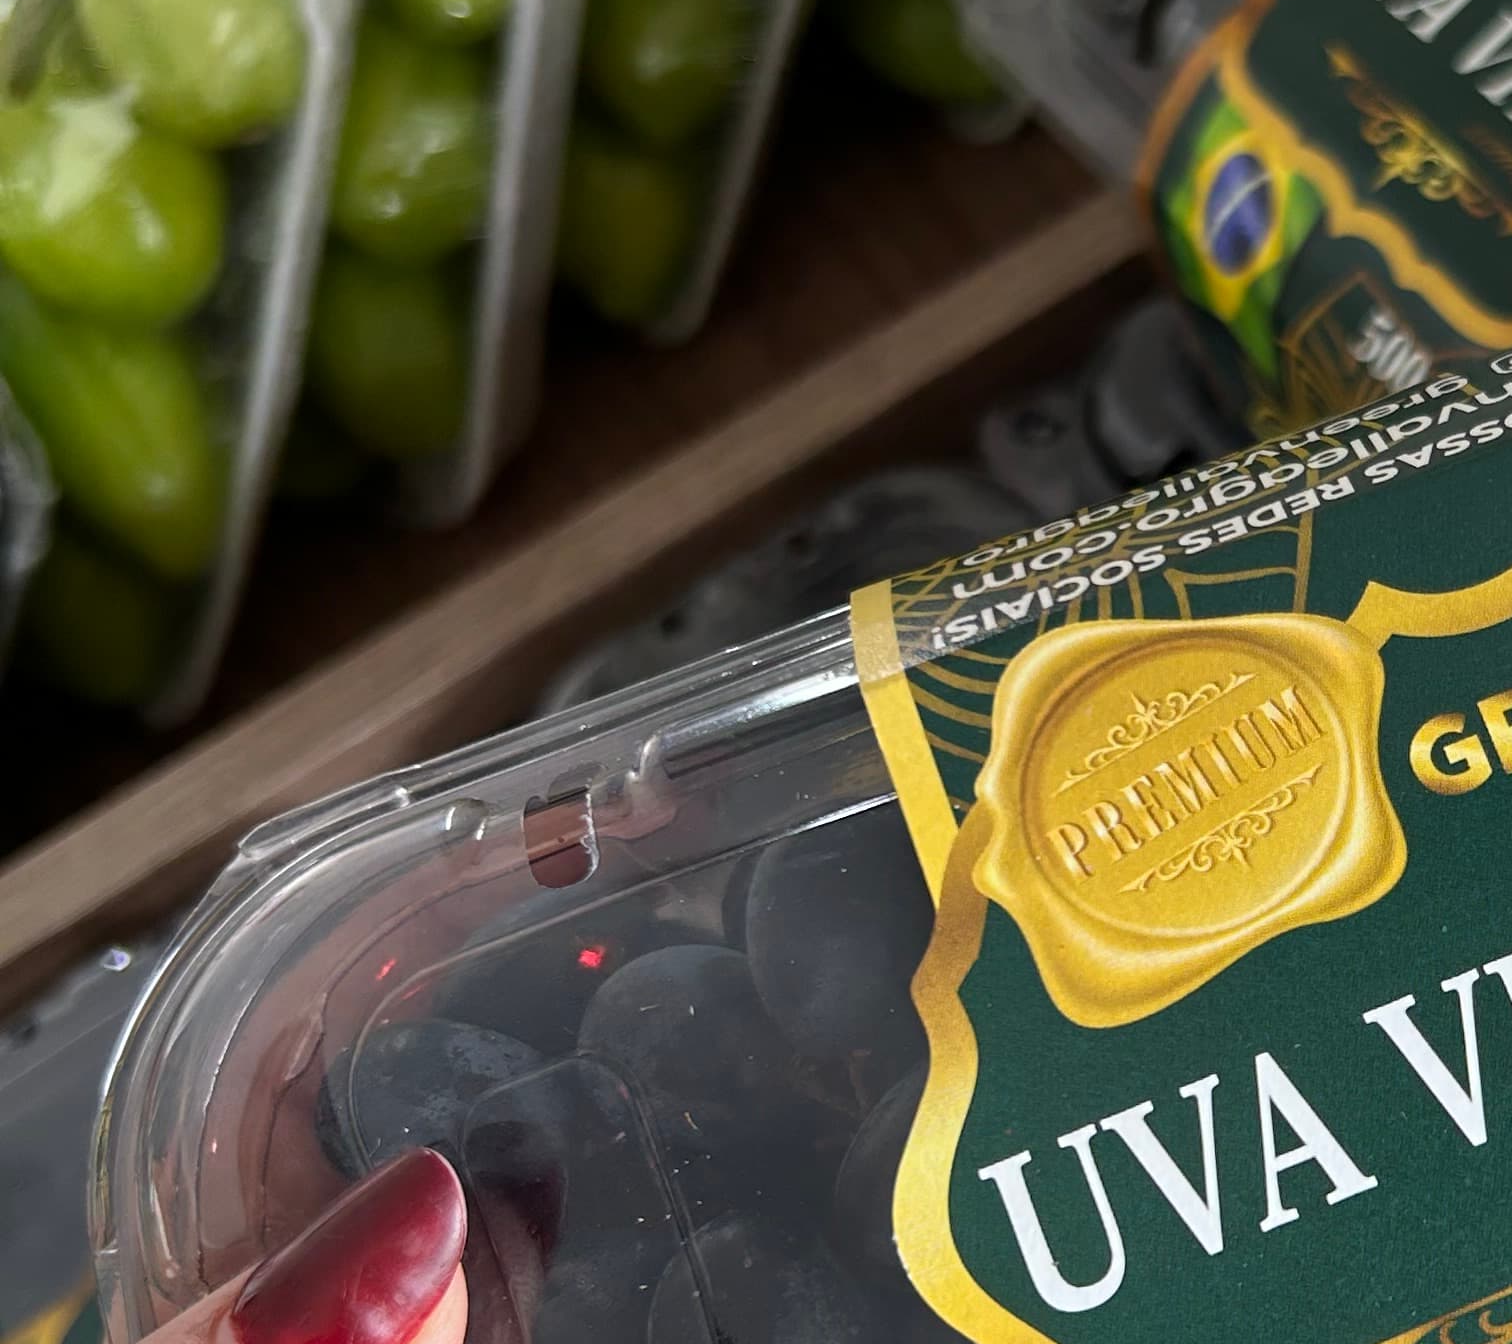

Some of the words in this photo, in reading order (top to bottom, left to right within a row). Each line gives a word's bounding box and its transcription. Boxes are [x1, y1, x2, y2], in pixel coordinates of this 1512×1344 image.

[1177, 476, 1357, 555] REDES
[932, 544, 1167, 651] SOCIAIS!
[1045, 680, 1328, 882] PREMIUM
[978, 1050, 1379, 1314] UVA
